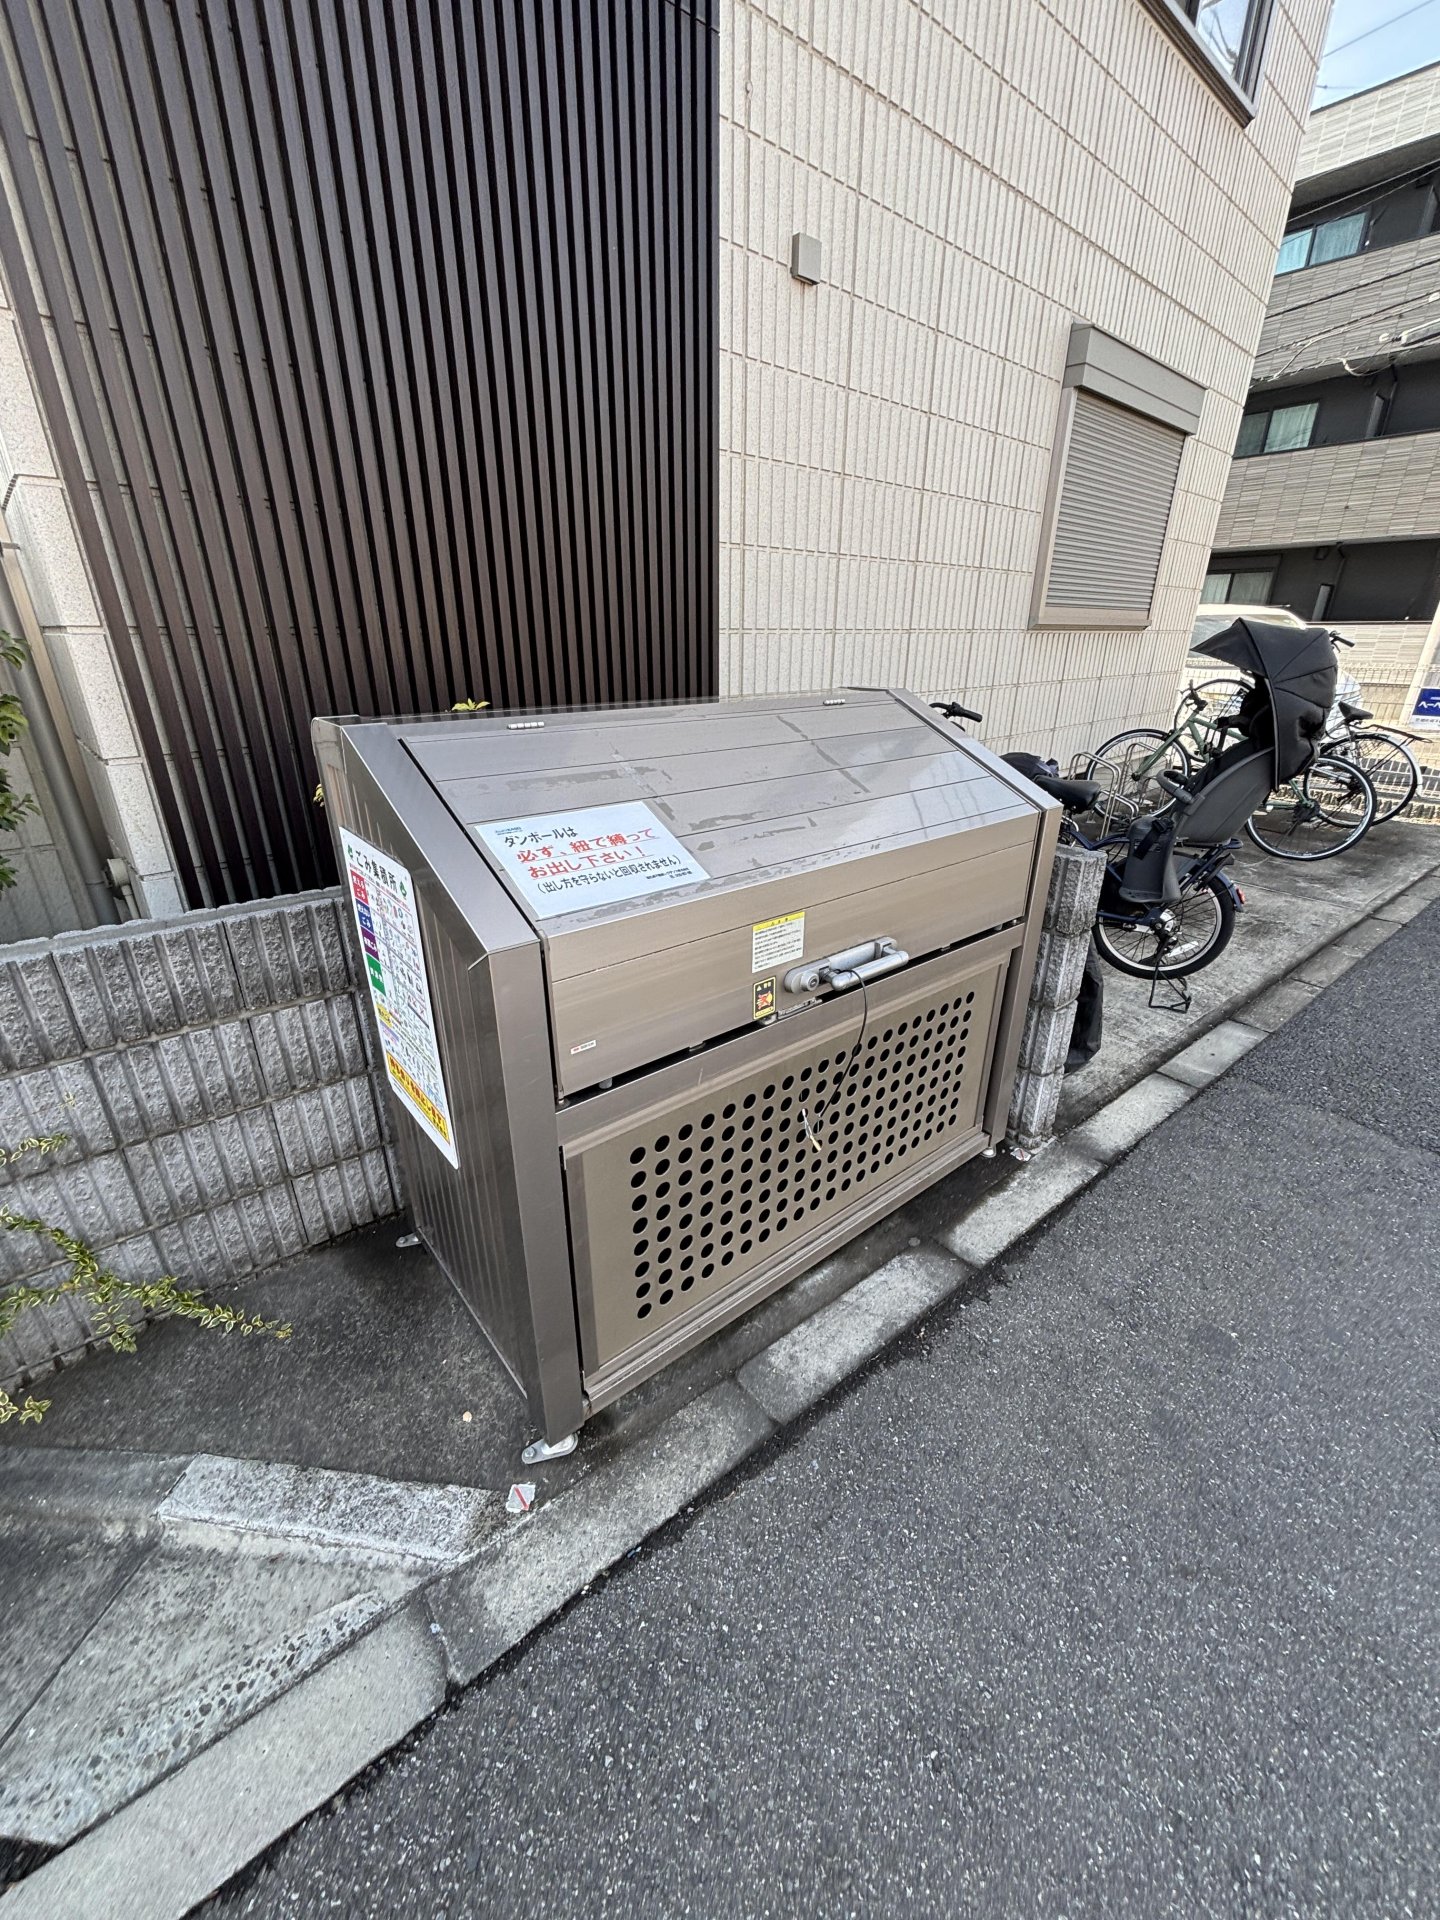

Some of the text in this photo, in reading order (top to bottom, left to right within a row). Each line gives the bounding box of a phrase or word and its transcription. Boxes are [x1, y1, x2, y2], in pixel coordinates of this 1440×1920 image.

[504, 826, 578, 848] ダンボールは
[516, 827, 656, 863] 必ず、紐で縛って
[355, 849, 398, 895] ごみ集積所
[527, 846, 646, 878] お出し下さい！
